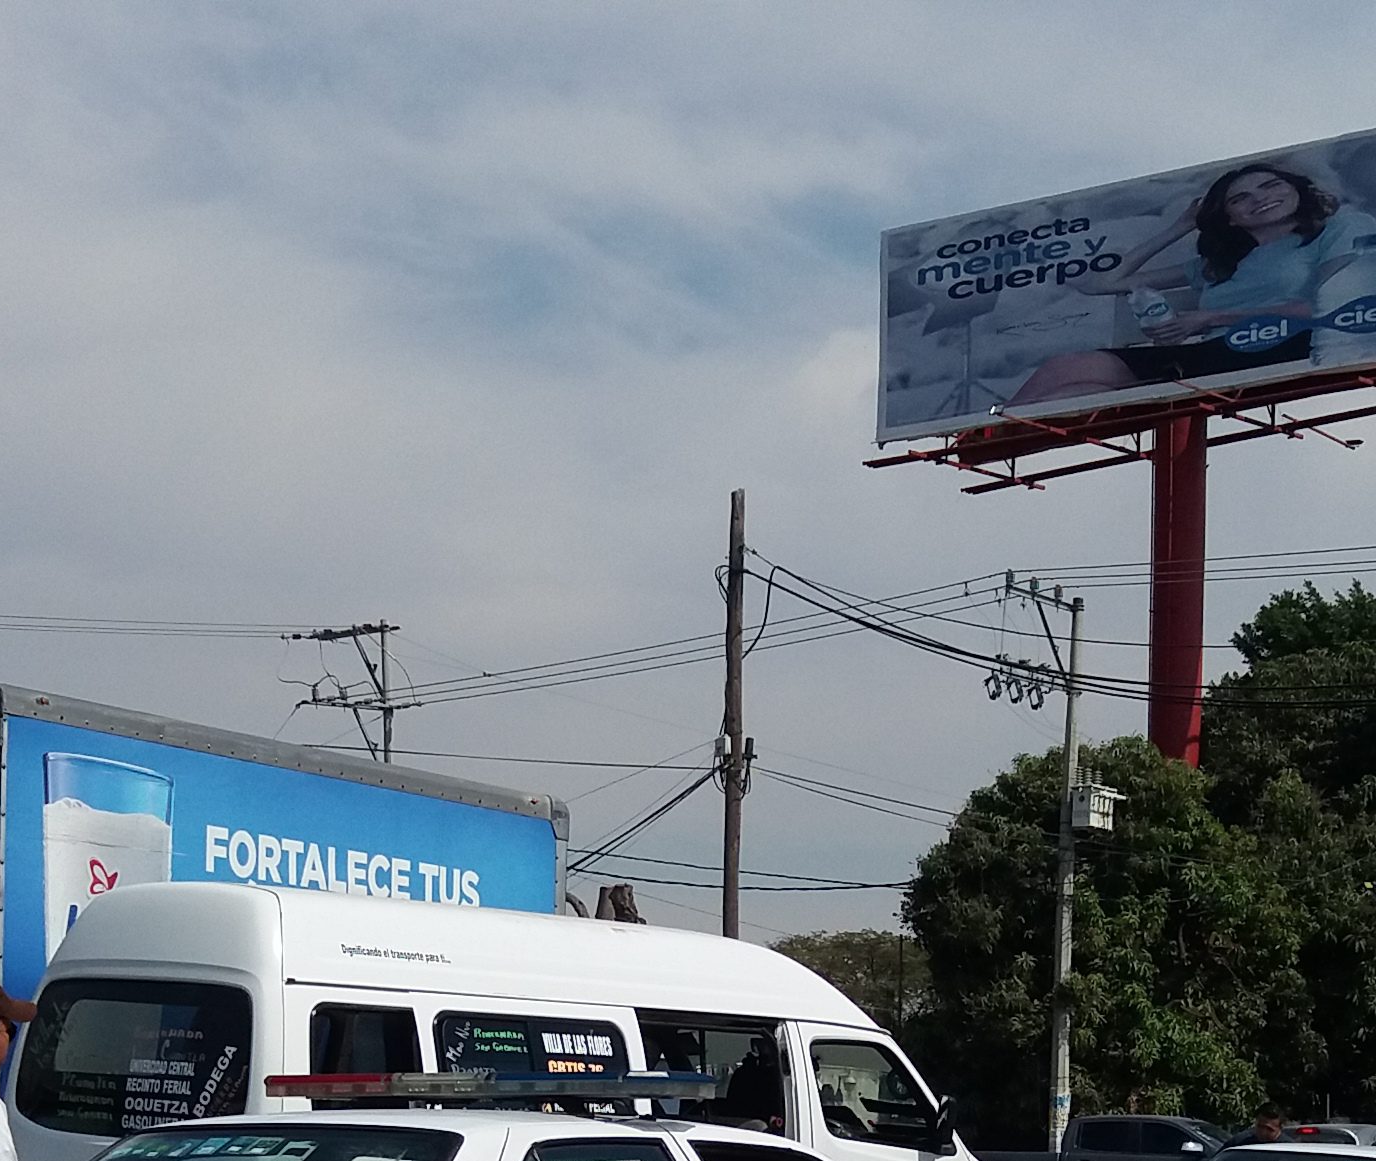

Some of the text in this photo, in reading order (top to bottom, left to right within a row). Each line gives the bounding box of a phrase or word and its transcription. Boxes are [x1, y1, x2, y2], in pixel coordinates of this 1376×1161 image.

[937, 217, 1091, 259] conecta
[917, 236, 1107, 286] mente y
[948, 253, 1122, 299] cuerpo
[1229, 319, 1288, 345] ciel
[205, 825, 480, 907] FORTALECE TUS
[341, 944, 382, 957] Dignificando
[390, 949, 424, 962] transporte
[541, 1032, 613, 1057] VILLA DE LAS FLORES
[167, 1061, 195, 1077] CENTRAL
[125, 1077, 161, 1094] RECINTO
[162, 1080, 192, 1096] FERIAL
[192, 1045, 238, 1119] BODEGA
[124, 1097, 189, 1115] OQUETZA
[121, 1114, 185, 1130] GASOLINE
